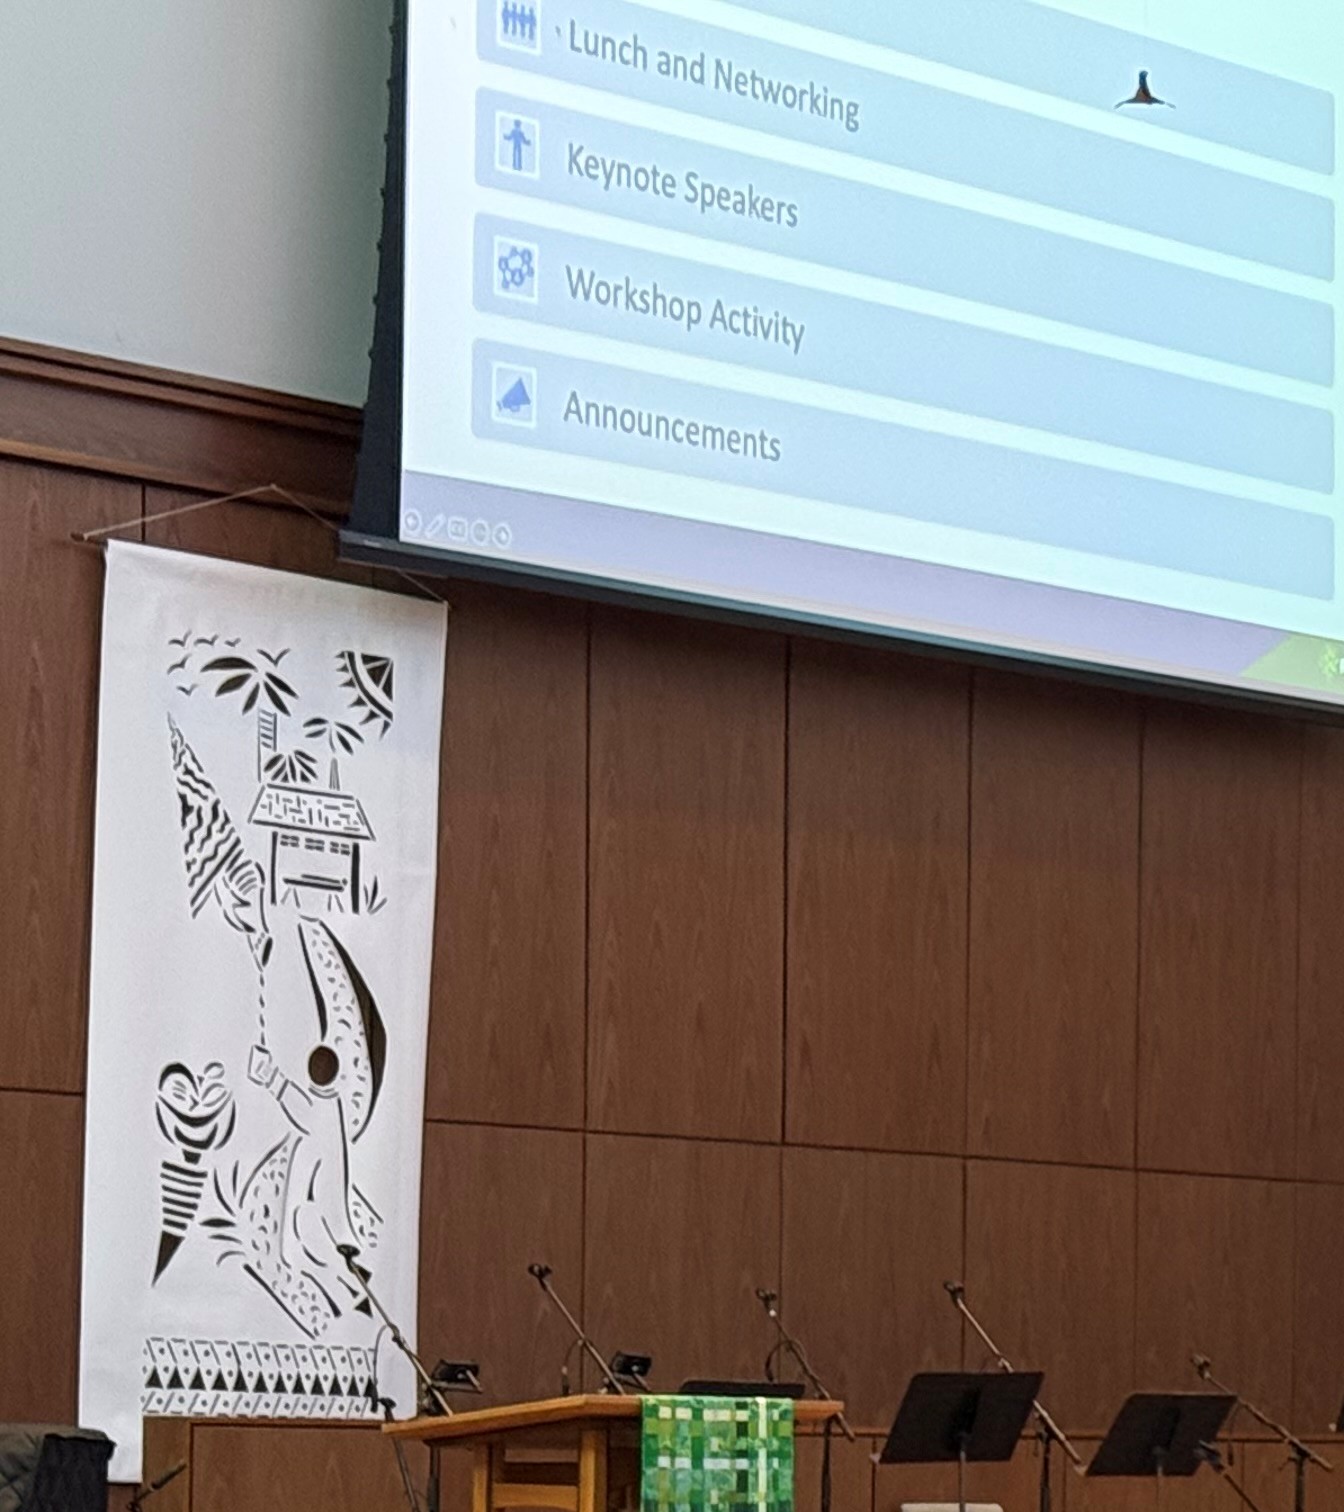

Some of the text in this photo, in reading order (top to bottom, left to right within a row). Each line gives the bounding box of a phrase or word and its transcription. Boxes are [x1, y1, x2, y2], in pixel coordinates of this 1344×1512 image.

[569, 18, 860, 133] Lunch and Networking
[567, 141, 799, 228] Keynote Speakers
[565, 263, 806, 355] Workshop Activity
[563, 389, 782, 462] Announcements
